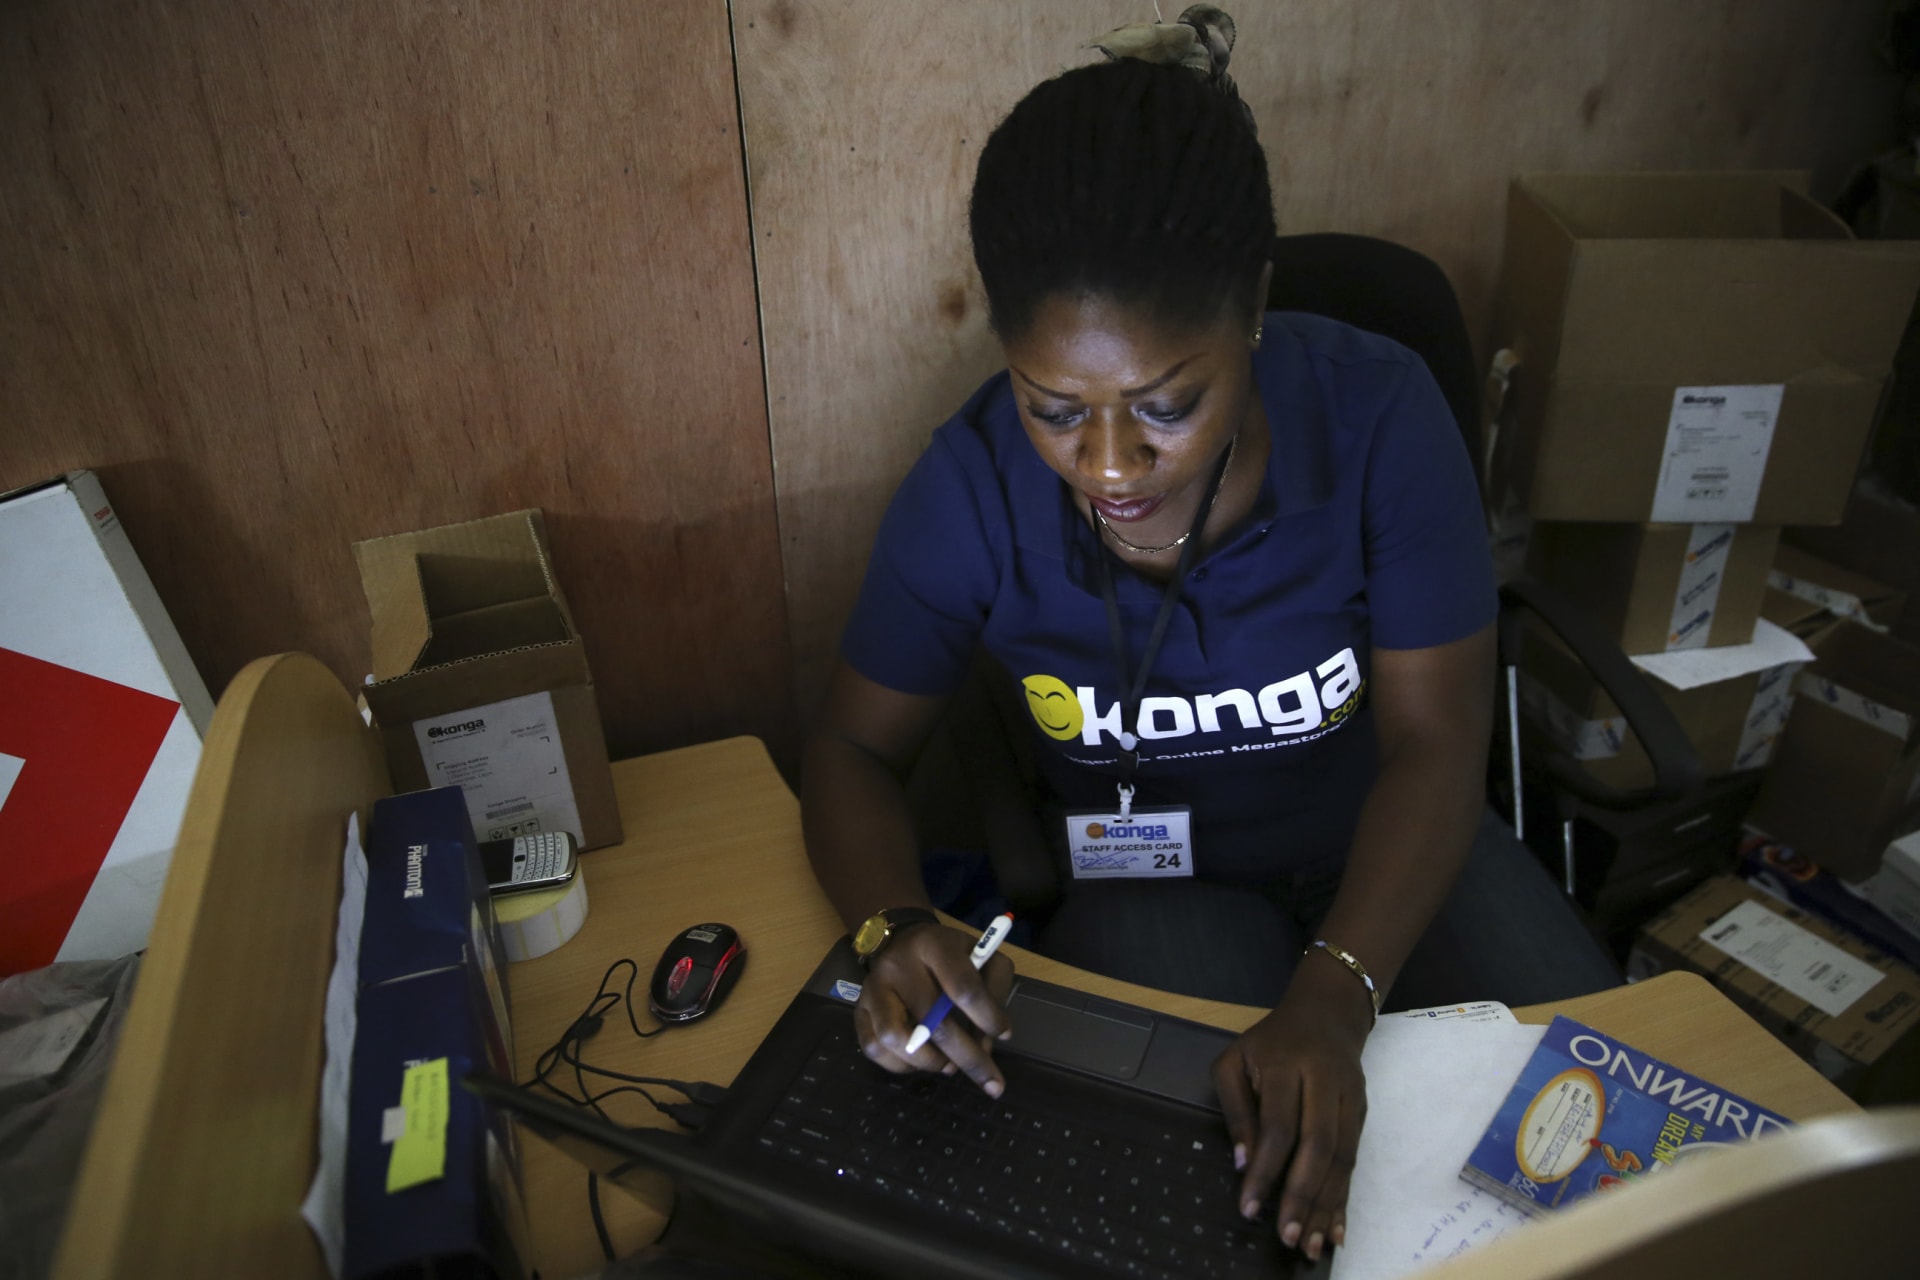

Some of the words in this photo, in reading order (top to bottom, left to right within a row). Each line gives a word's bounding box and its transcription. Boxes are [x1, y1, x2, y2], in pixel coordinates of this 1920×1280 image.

[1076, 647, 1361, 746] konga
[439, 718, 485, 737] konga
[1156, 748, 1225, 760] Online
[1103, 824, 1168, 841] konga
[1082, 844, 1111, 852] STAFF
[1113, 843, 1153, 852] ACCESS
[1155, 842, 1183, 850] CARD
[1153, 853, 1182, 869] 24
[1651, 1112, 1691, 1167] DREAM
[1690, 1122, 1706, 1142] MY
[1518, 1176, 1540, 1199] 60
